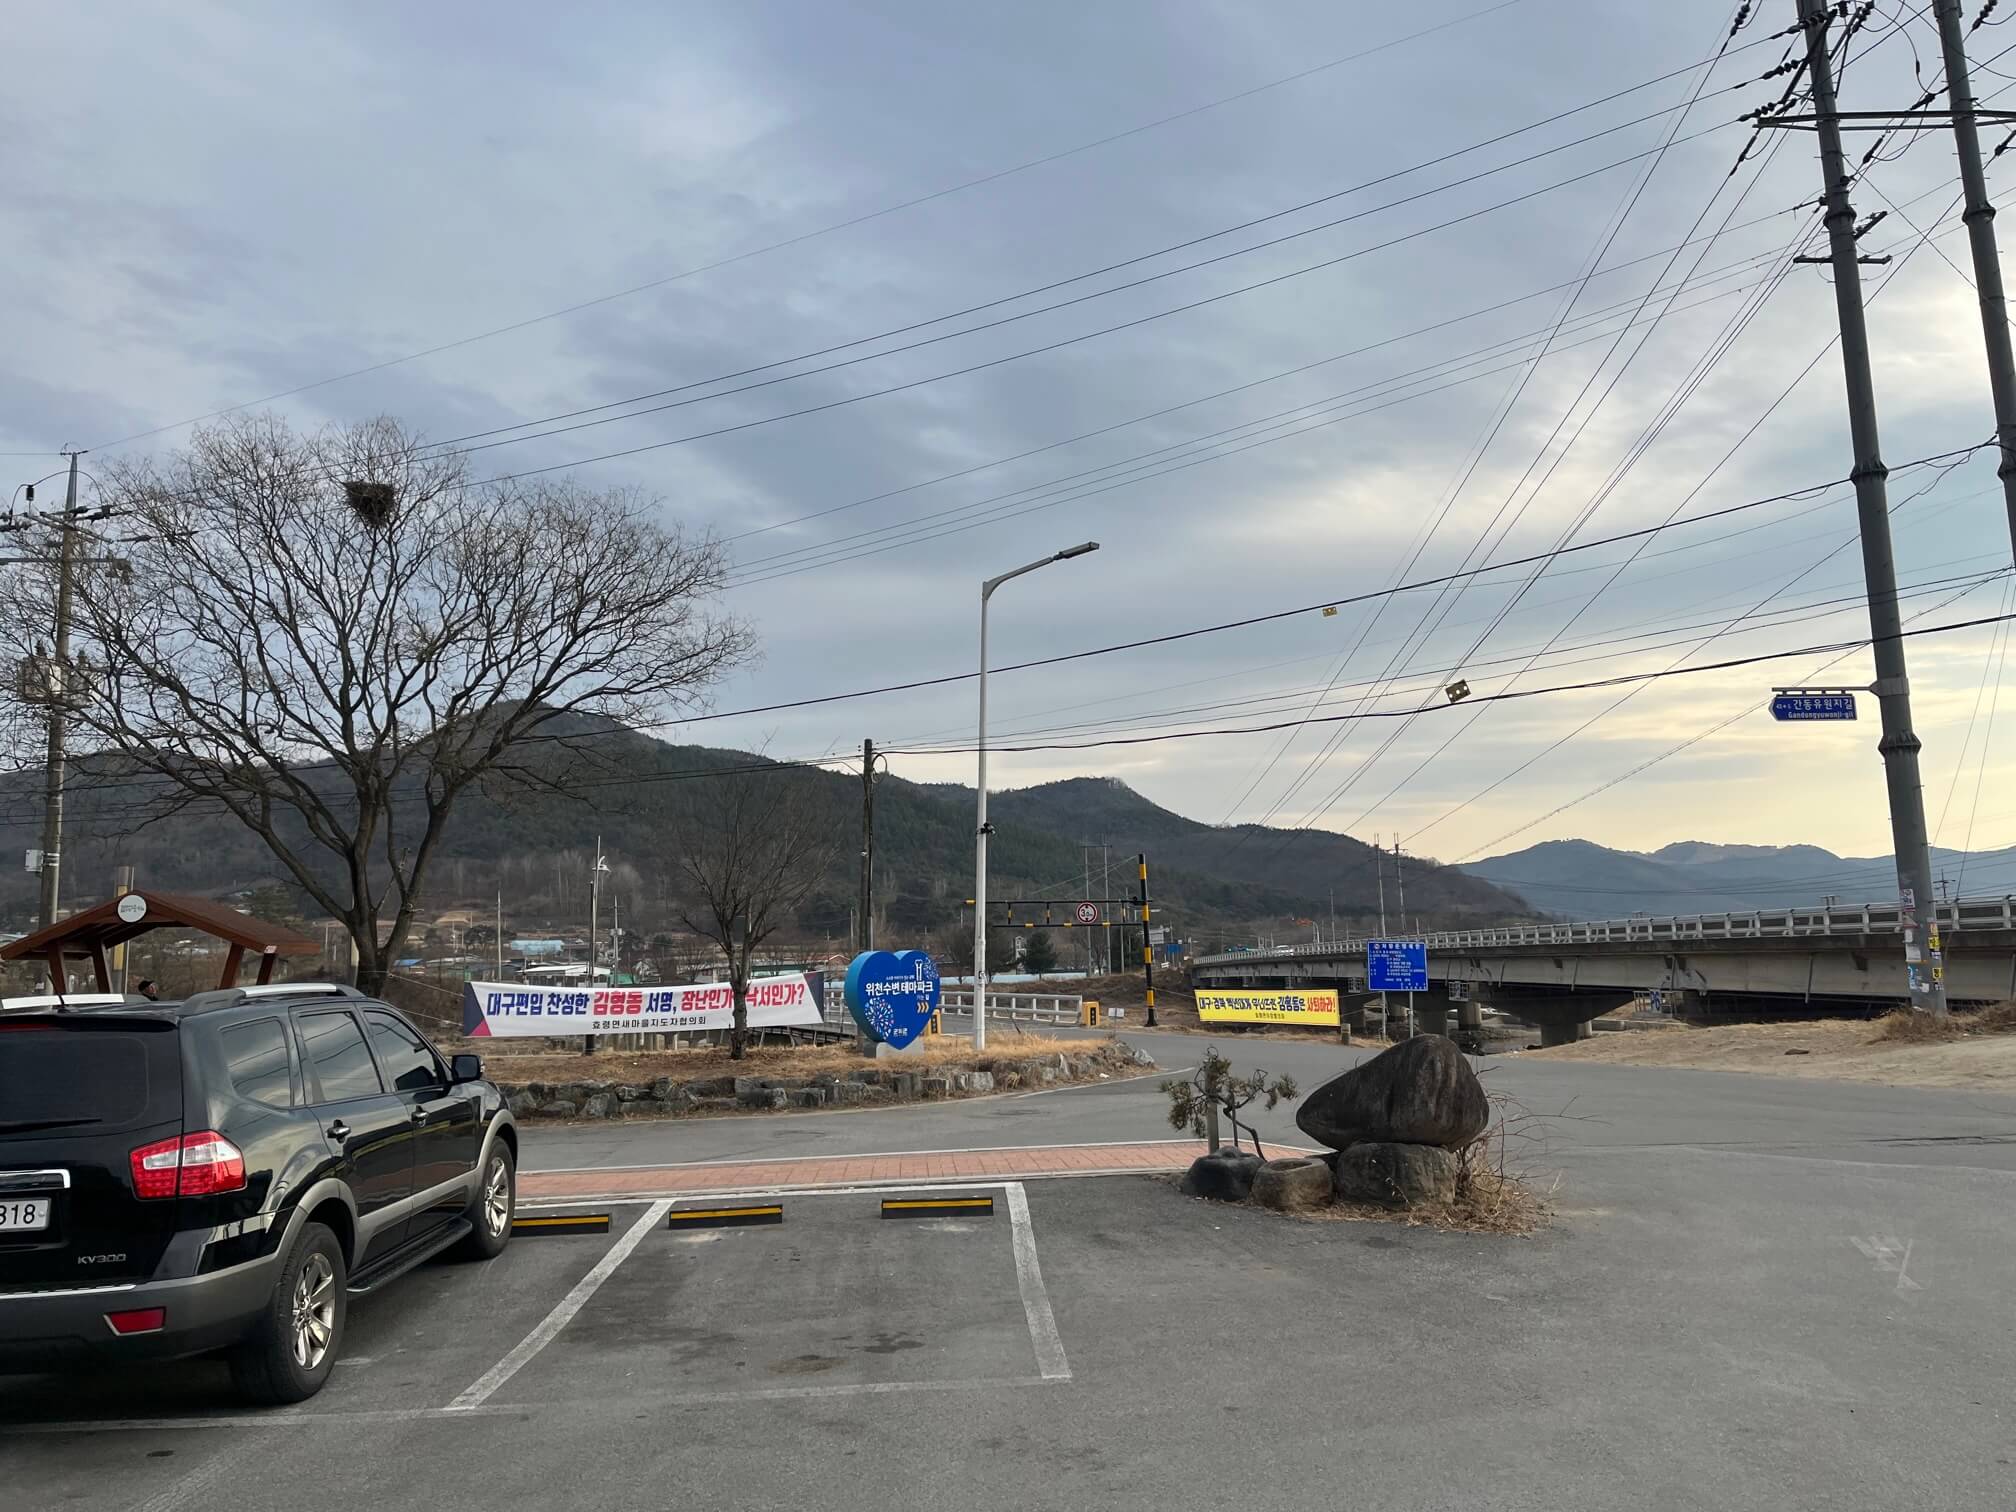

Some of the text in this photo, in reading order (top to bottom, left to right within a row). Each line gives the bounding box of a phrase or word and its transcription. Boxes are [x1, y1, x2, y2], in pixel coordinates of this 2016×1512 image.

[1793, 698, 1853, 711] 간동유원지길
[865, 981, 934, 997] 위천수변 테마파크
[486, 983, 805, 1016] 대구편입 찬성한 김형동 서명, 장난인가 낙서인가?
[1278, 995, 1306, 1012] 김형동은
[1307, 996, 1336, 1013] 사퇴하라!
[78, 1253, 127, 1265] KV300
